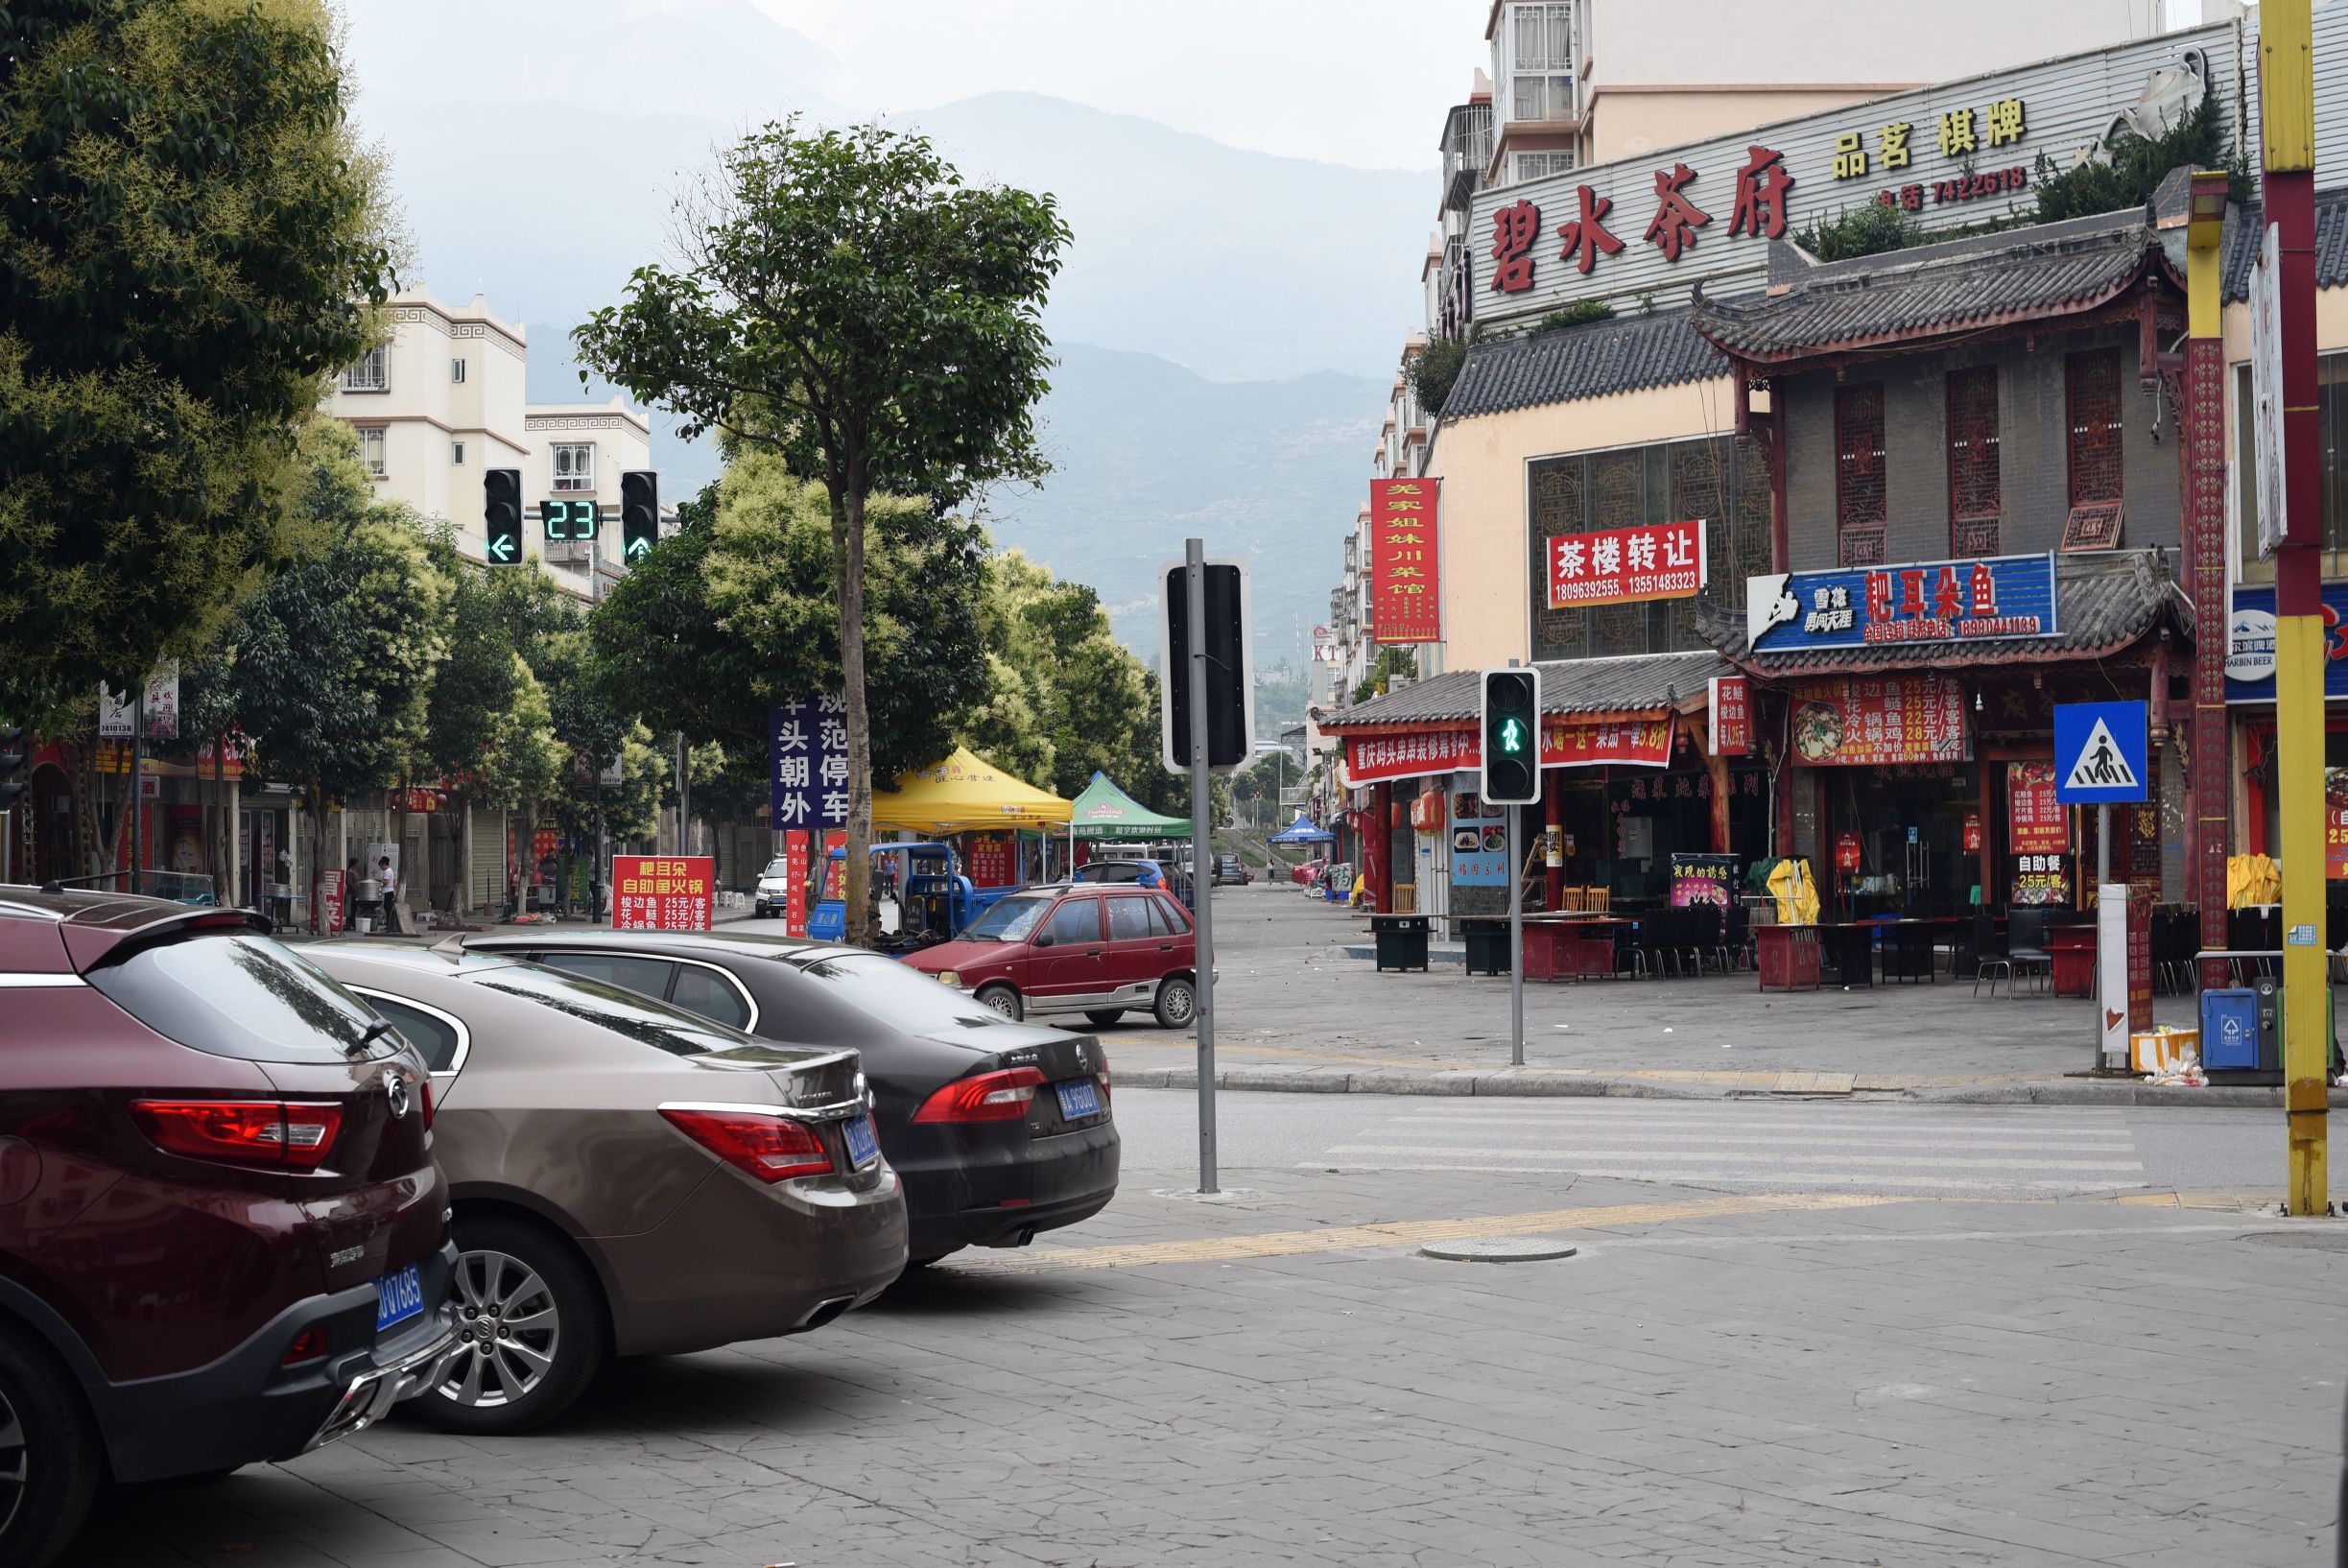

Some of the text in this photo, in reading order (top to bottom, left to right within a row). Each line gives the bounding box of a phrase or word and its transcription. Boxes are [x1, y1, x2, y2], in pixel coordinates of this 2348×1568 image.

[1931, 165, 2028, 203] 7422618
[1490, 144, 1796, 294] 碧水茶府
[547, 501, 594, 539] 23
[1557, 529, 1694, 579] 茶楼转让
[2253, 655, 2273, 665] BEER
[1721, 685, 1743, 701] 花鲢
[1906, 694, 1959, 710] 25元/客
[1720, 703, 1744, 720] 梭边鱼
[1845, 710, 1960, 727] 冷锅鱼 22元/客
[1719, 724, 1744, 748] 每人25元
[1845, 726, 1904, 744] 火锅鸡
[2019, 855, 2061, 872] 自助餐
[623, 878, 703, 894] 自助鱼火锅
[1334, 867, 1351, 891] 药
[2019, 874, 2062, 889] 25元/客
[620, 895, 706, 910] 梭边鱼 25元/客
[664, 908, 706, 921] 25元/客
